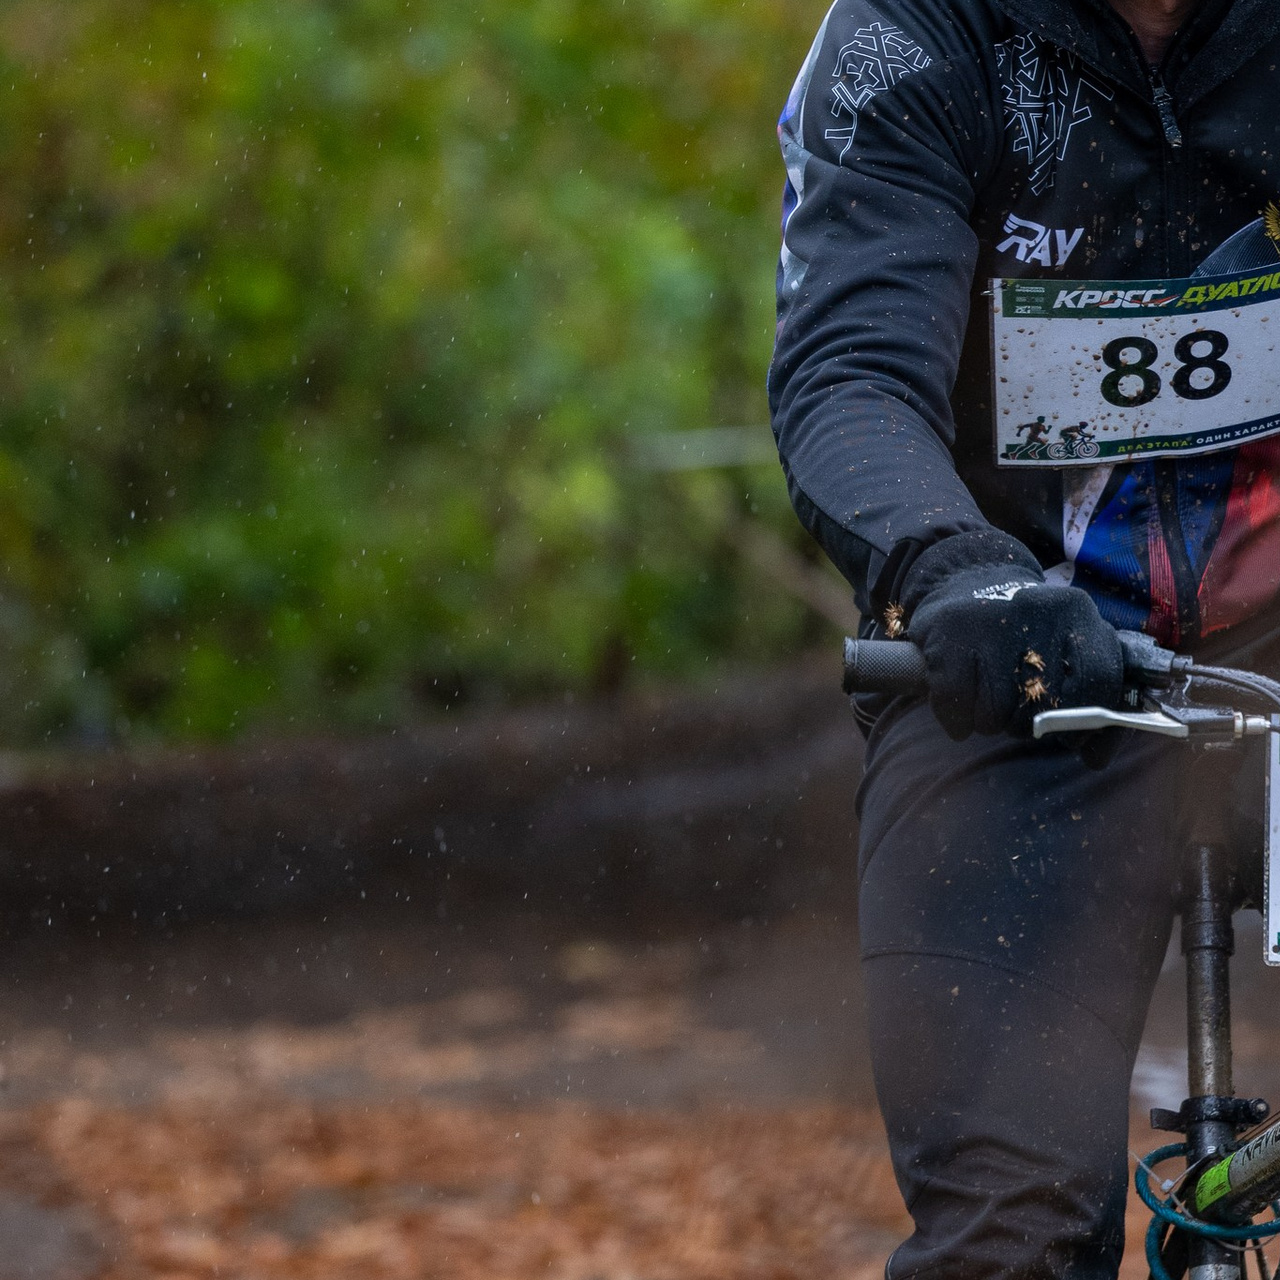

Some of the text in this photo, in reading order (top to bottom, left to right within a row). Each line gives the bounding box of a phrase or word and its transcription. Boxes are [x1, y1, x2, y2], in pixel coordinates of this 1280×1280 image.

[996, 213, 1084, 267] RAY
[1052, 289, 1170, 309] КРОСС
[1101, 329, 1232, 408] 88
[1196, 432, 1231, 445] ОДИН
